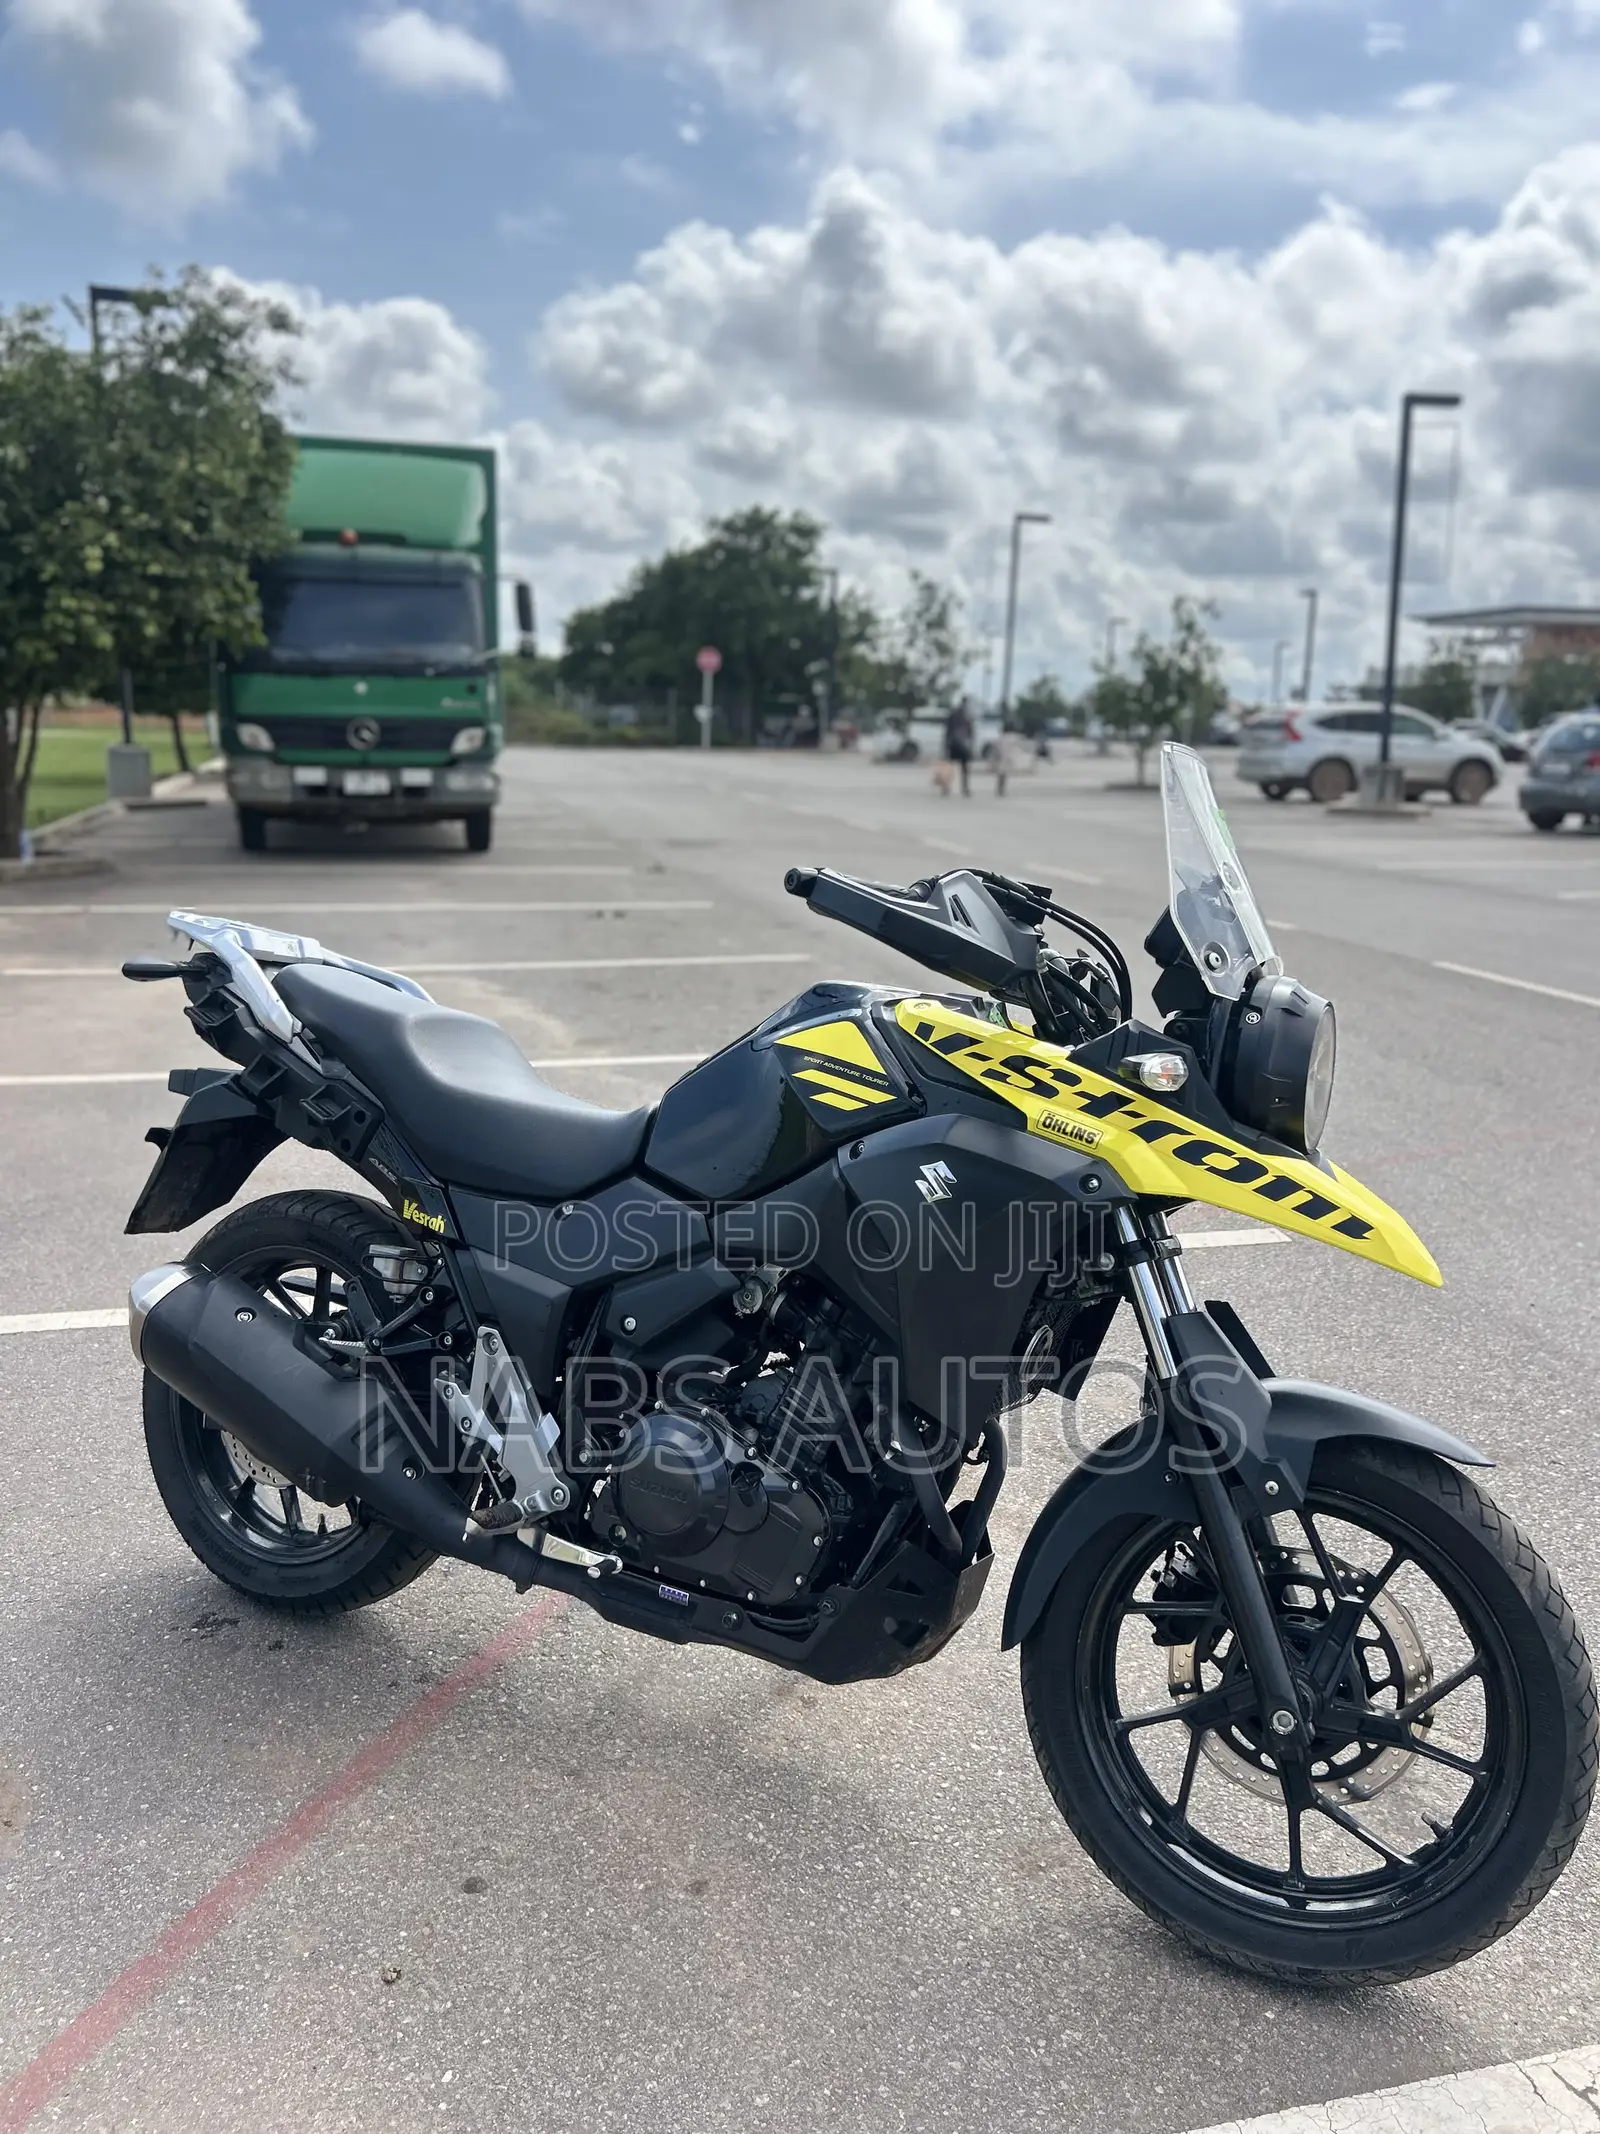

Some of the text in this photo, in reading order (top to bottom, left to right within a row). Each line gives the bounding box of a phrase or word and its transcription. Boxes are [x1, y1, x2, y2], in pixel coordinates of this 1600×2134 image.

[803, 1055, 890, 1087] SPORT ADVENTURE TOURER
[1041, 1112, 1098, 1145] ÖHLINS
[403, 1199, 445, 1234] Vesrah
